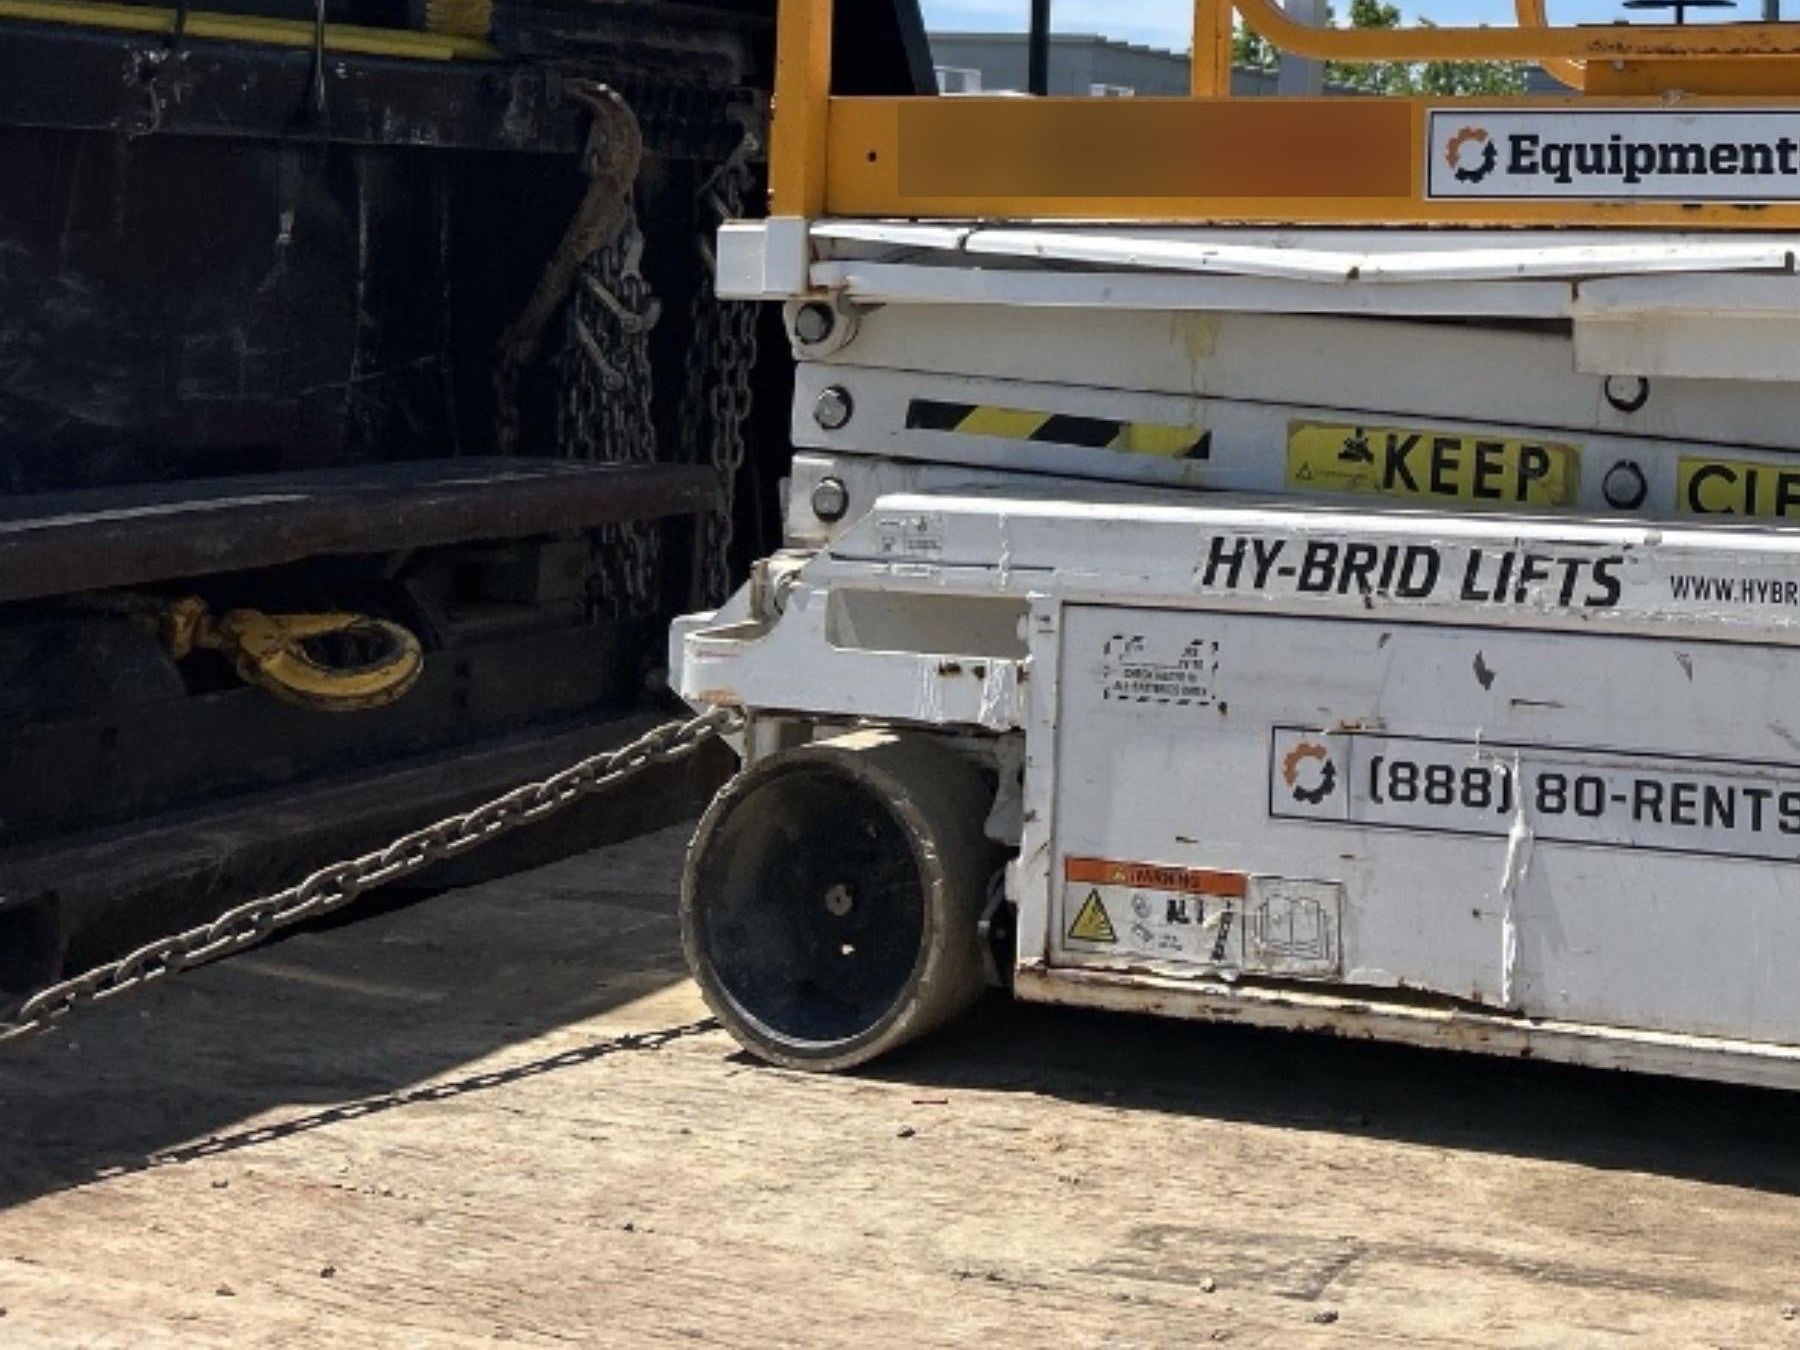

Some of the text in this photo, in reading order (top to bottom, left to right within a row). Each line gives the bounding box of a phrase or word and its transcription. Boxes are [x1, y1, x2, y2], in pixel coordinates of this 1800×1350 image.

[1383, 433, 1550, 502] KEEP
[1202, 536, 1625, 607] HY-BRID LIFTS
[1369, 755, 1513, 814] (888)
